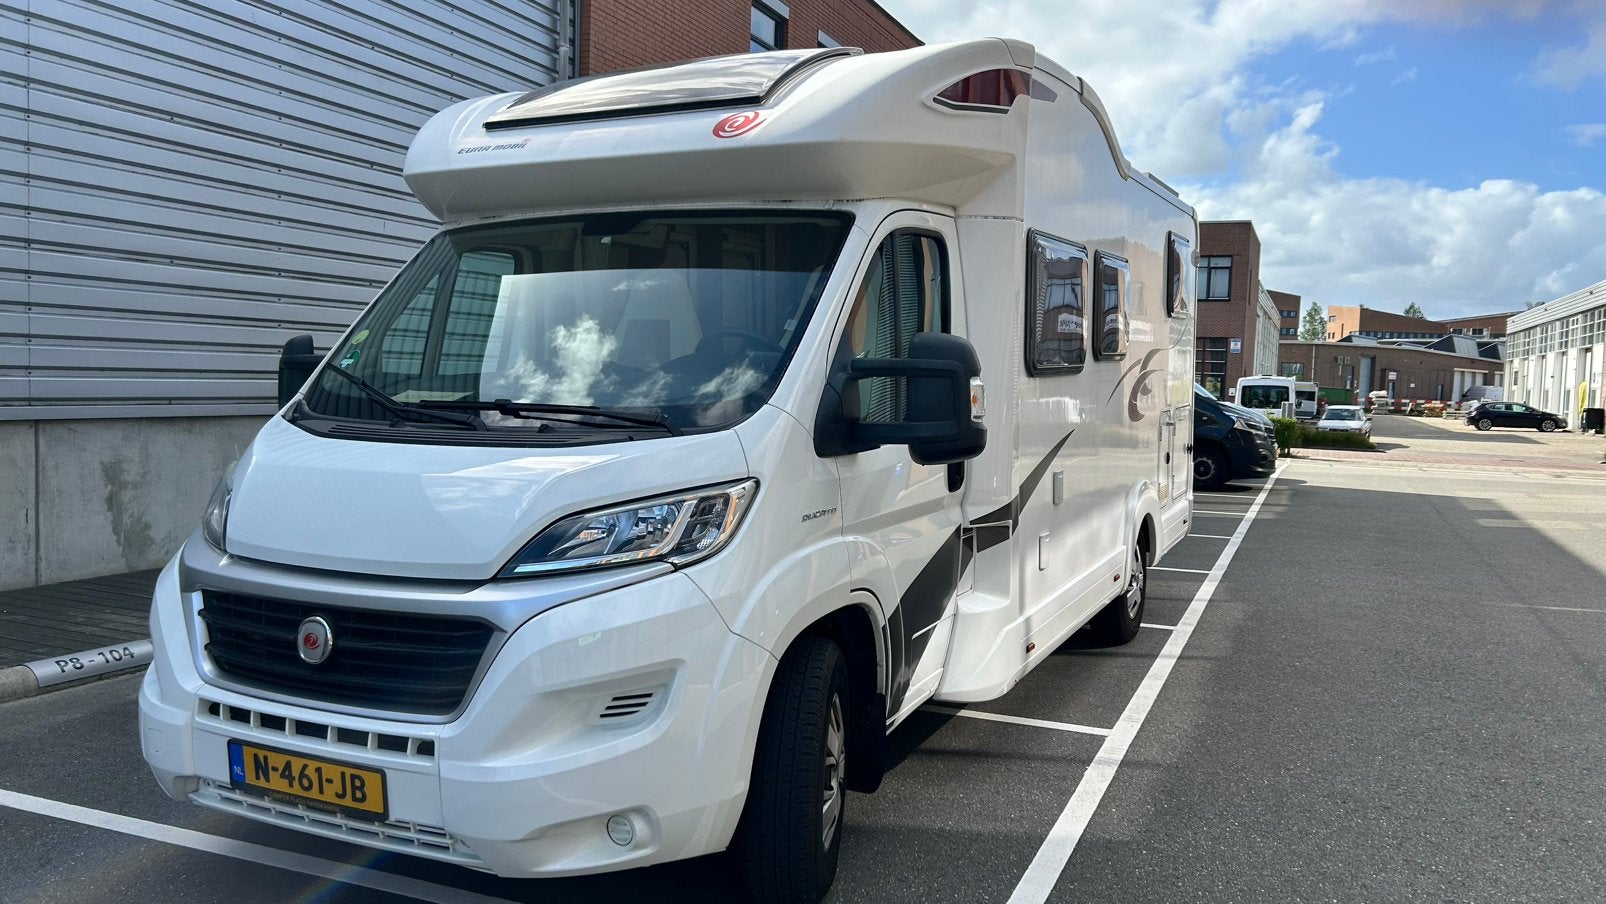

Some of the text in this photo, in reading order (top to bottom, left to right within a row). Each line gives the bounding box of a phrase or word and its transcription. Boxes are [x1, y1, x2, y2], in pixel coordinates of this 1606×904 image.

[457, 145, 491, 155] EURA
[54, 657, 85, 674] P8
[97, 646, 135, 664] 104
[233, 765, 244, 776] NL
[253, 752, 367, 803] N-461-JB
